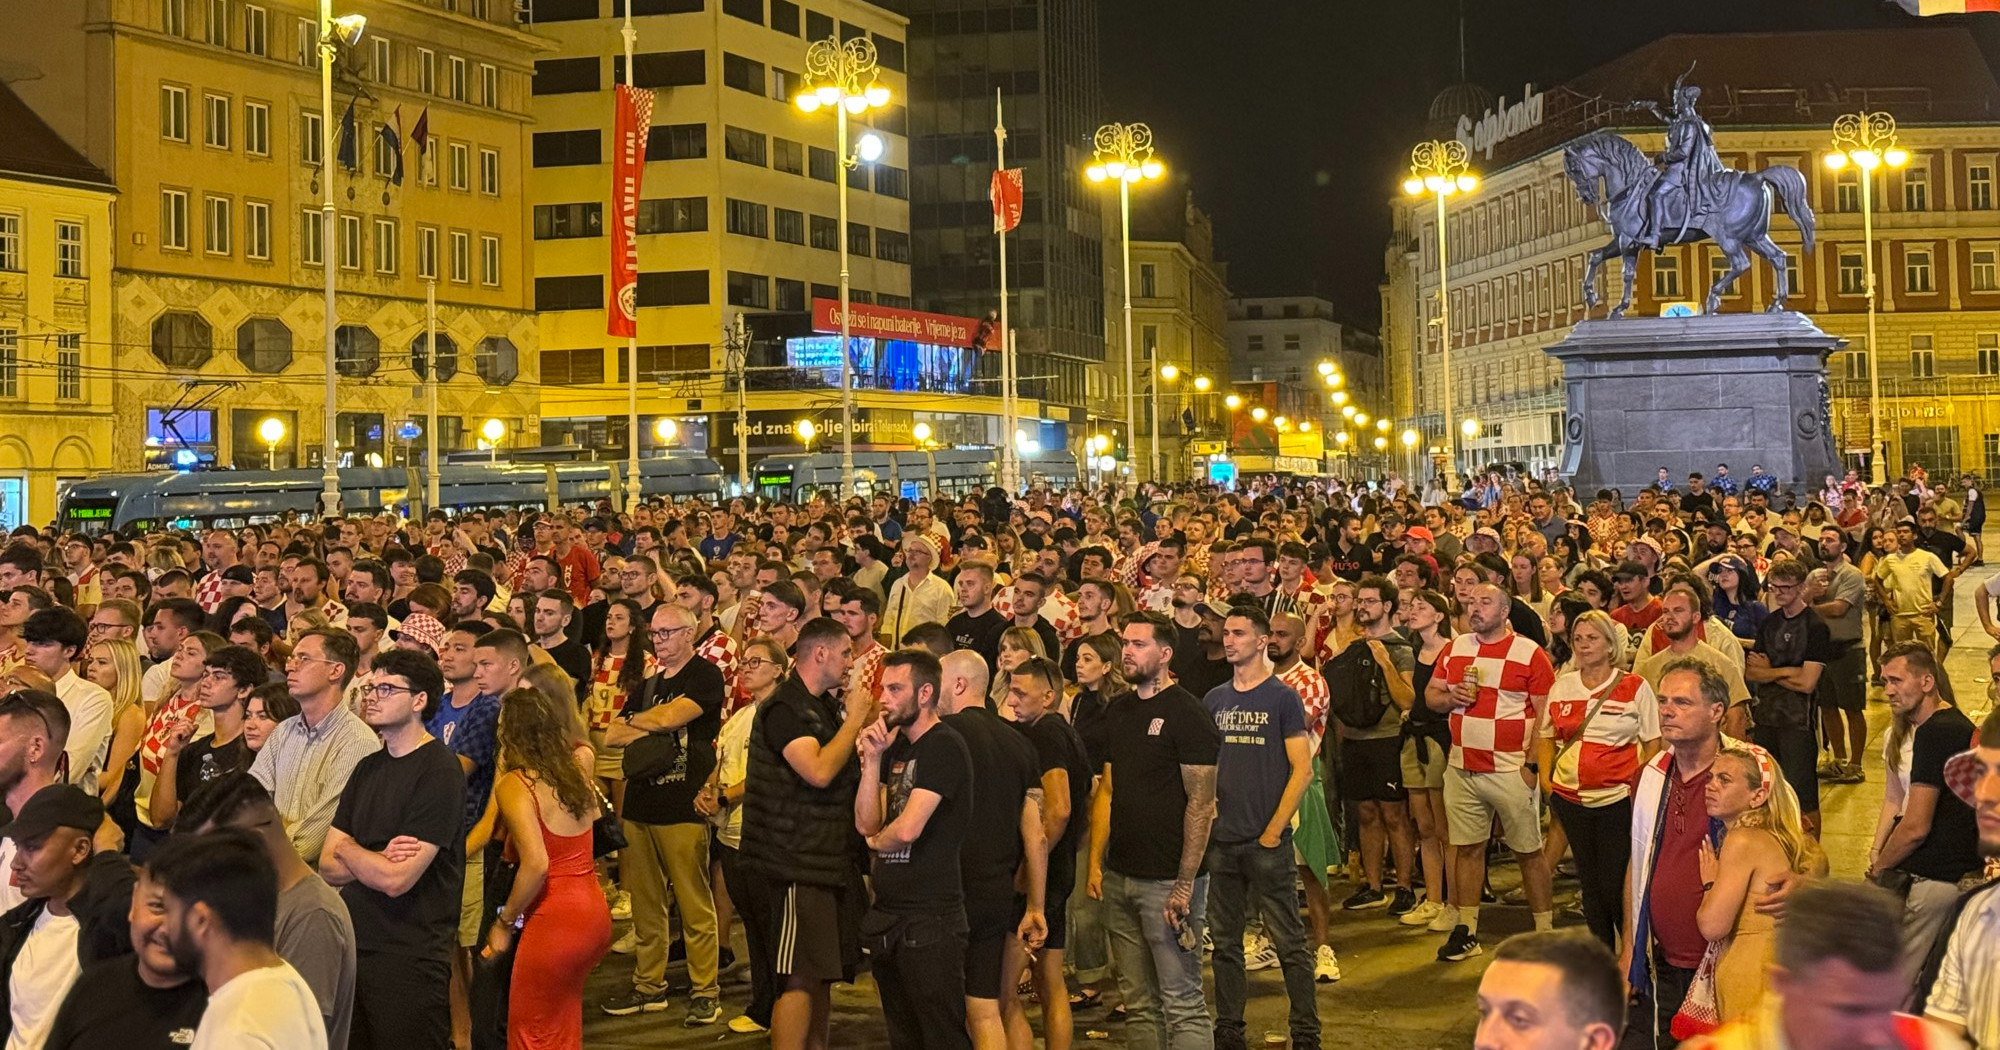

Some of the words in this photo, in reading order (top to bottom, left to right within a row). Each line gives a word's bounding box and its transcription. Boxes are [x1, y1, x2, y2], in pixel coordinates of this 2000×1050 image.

[870, 314, 895, 334] napuni
[895, 315, 923, 338] baterije.
[925, 318, 951, 340] Vrijeme
[951, 322, 958, 342] je
[958, 326, 967, 340] za
[815, 419, 843, 437] olje
[564, 565, 573, 593] HRV
